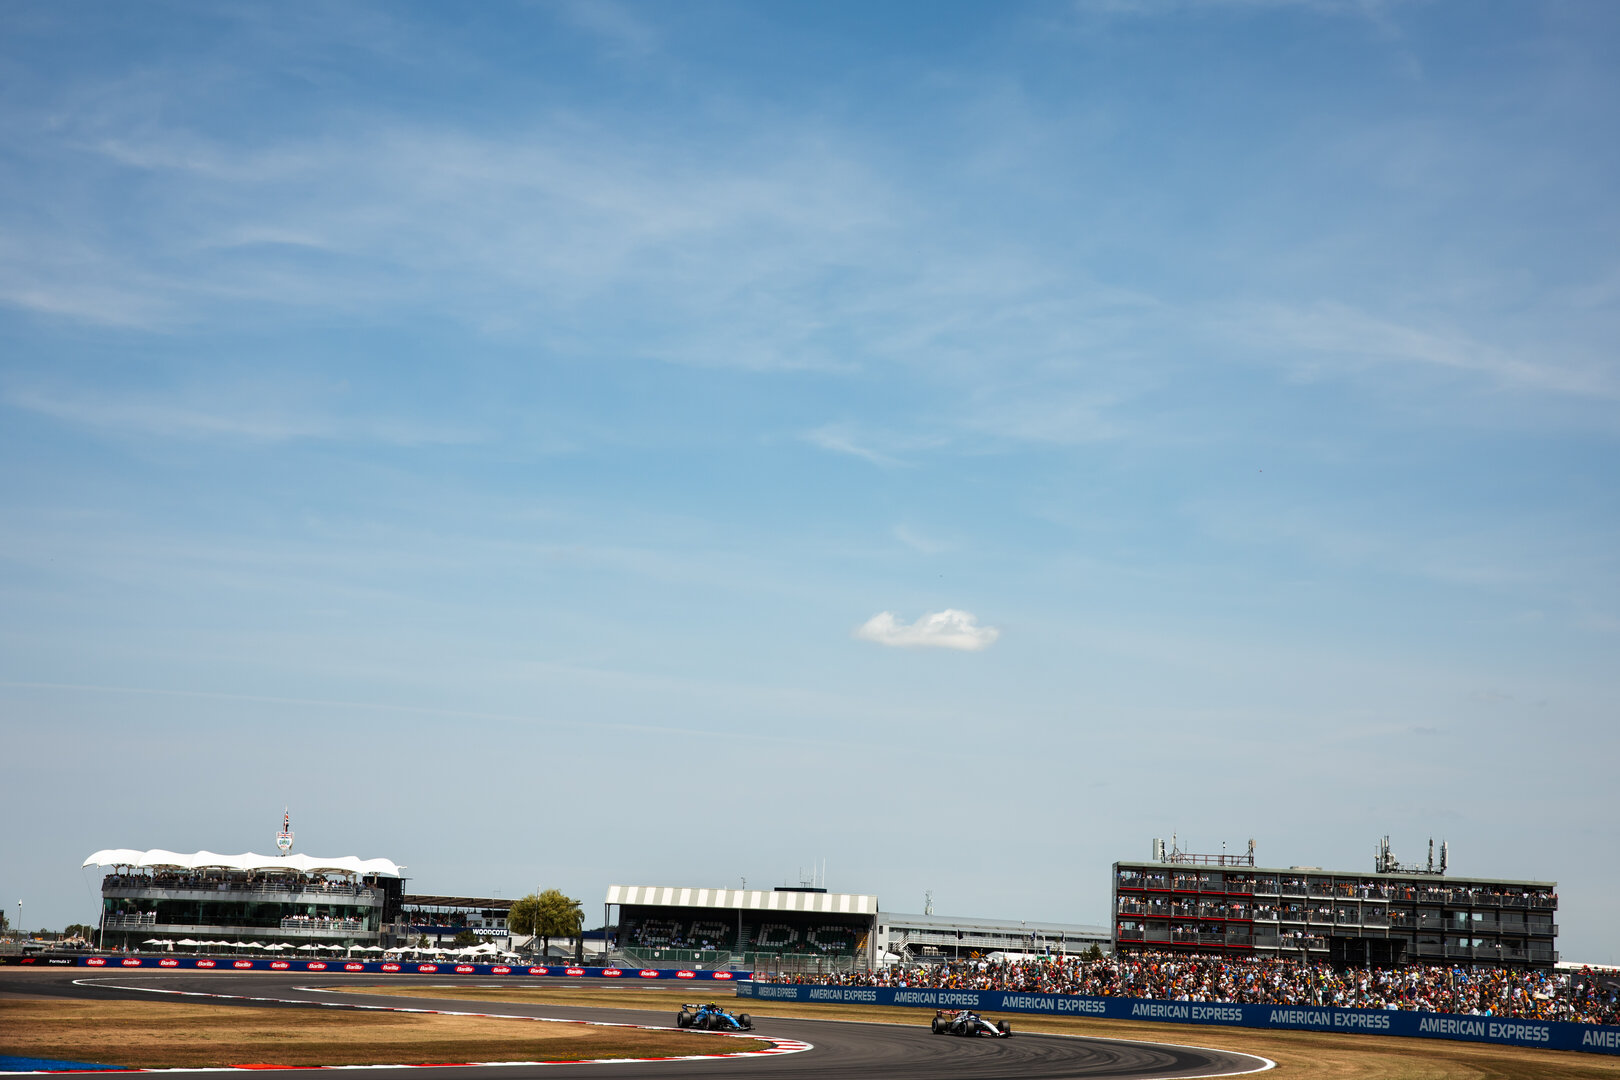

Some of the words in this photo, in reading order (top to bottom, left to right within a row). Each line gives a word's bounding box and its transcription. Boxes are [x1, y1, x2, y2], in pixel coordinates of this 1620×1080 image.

[472, 928, 508, 936] WOODCOTE
[758, 986, 776, 997] AMERICAN
[778, 988, 798, 998] EXPRESS
[809, 989, 842, 1000] AMERICAN
[844, 990, 877, 1001] EXPRESS
[894, 992, 936, 1004] AMERICAN
[938, 993, 979, 1006] EXPRESS
[1002, 996, 1055, 1010] AMERICAN
[1057, 999, 1106, 1012] EXPRESS
[1132, 1004, 1189, 1018] AMERICAN
[1192, 1006, 1243, 1021] EXPRESS
[1270, 1010, 1331, 1026] AMERICAN
[1334, 1012, 1390, 1029] EXPRESS
[1419, 1018, 1485, 1036] AMERICAN
[1489, 1023, 1550, 1042] EXPRESS
